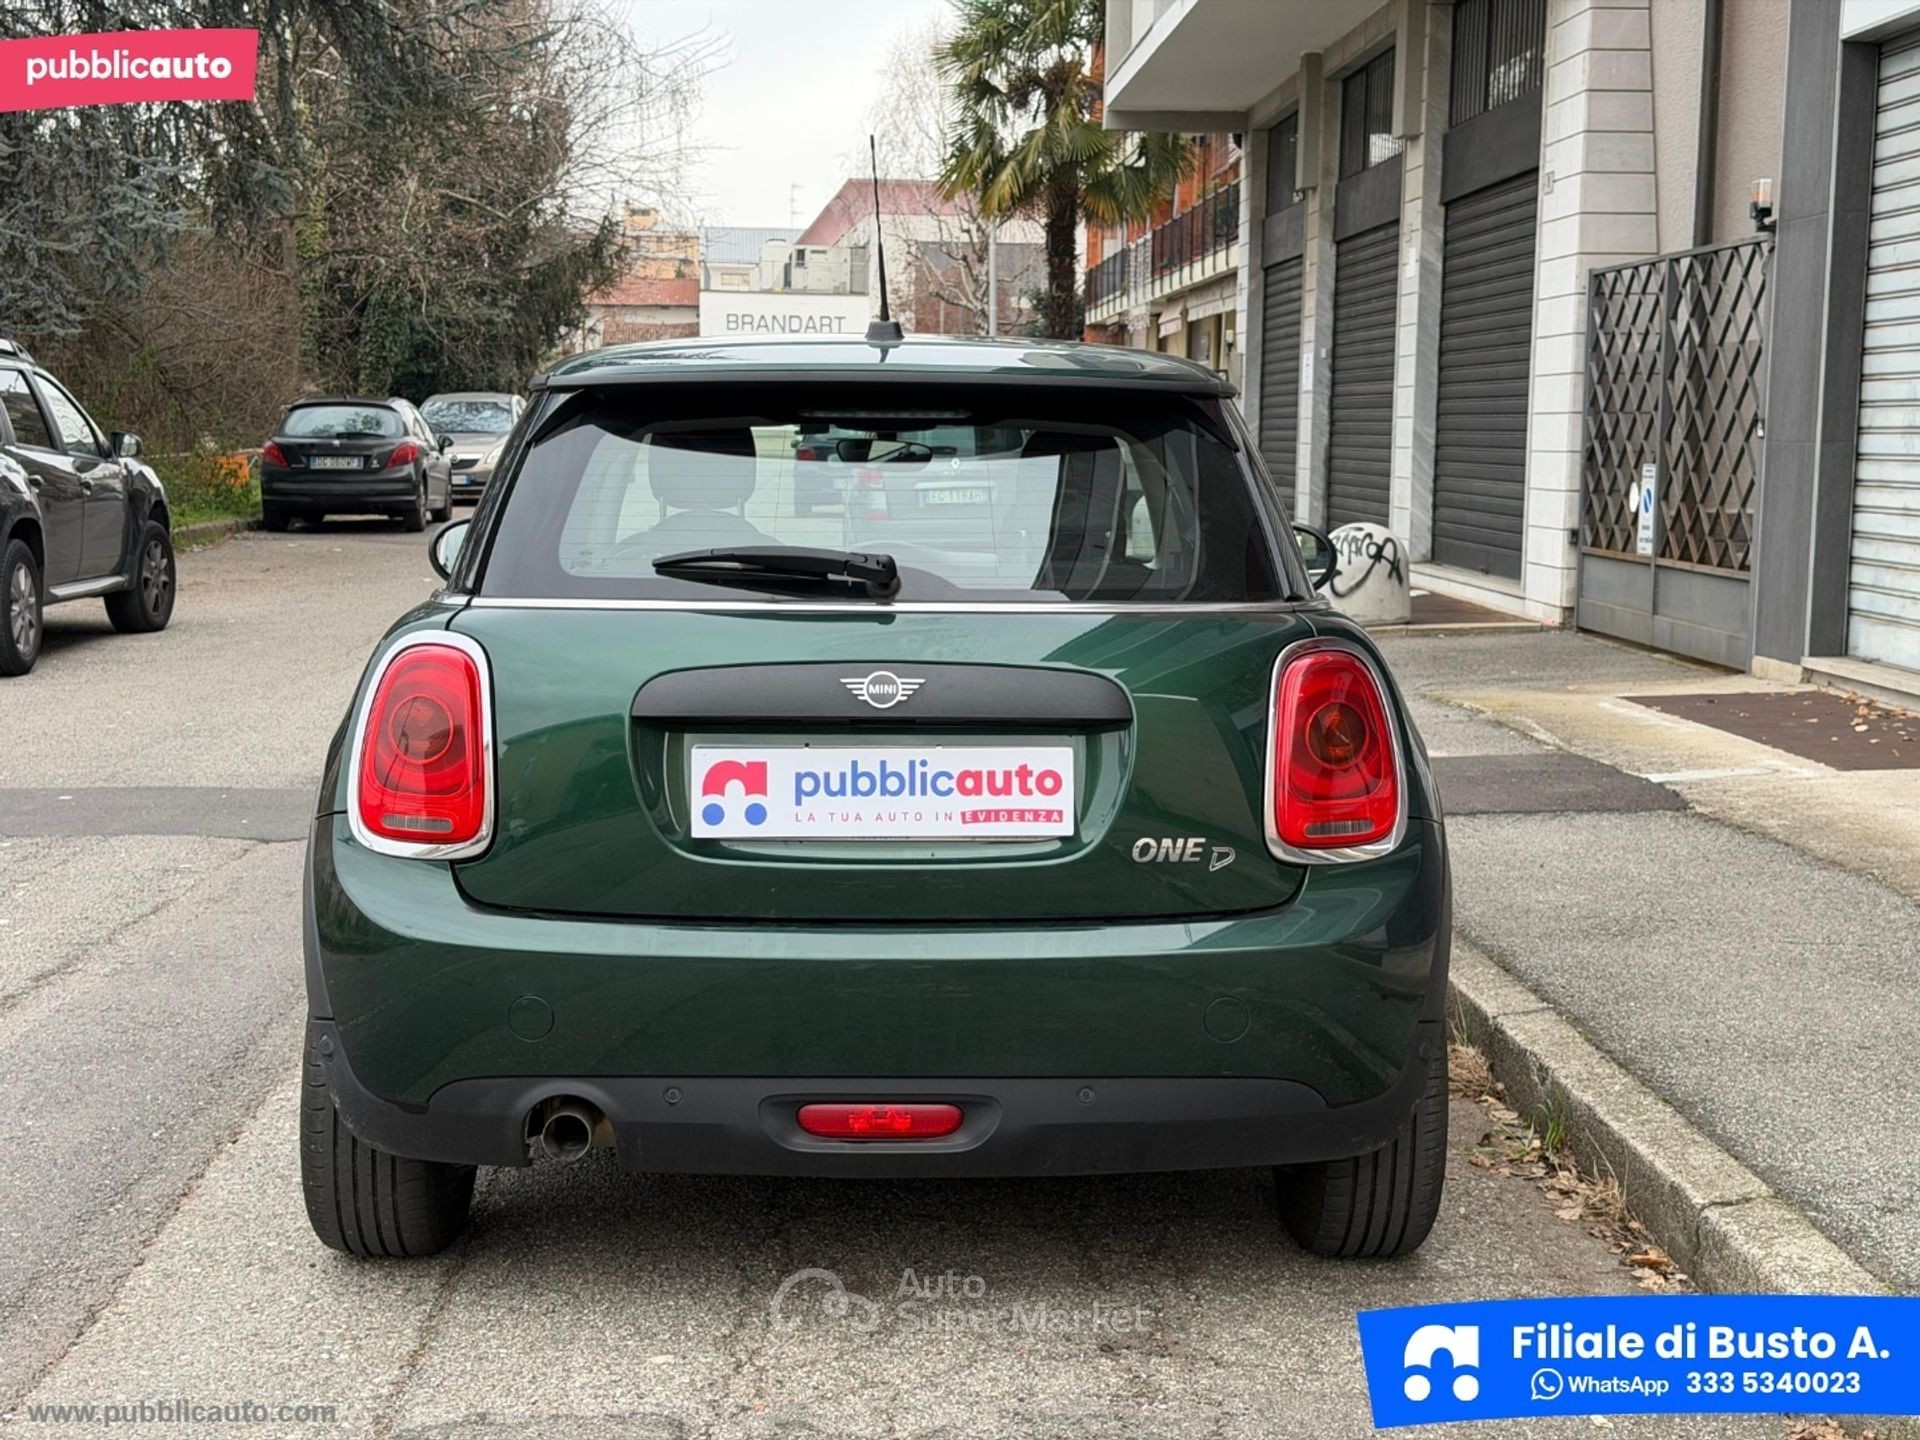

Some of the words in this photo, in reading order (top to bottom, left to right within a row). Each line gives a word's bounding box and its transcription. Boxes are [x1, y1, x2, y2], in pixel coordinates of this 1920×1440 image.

[726, 313, 847, 334] BRANDART
[868, 684, 898, 695] MINI
[794, 759, 1063, 807] pubblicauto
[795, 811, 816, 823] LA
[828, 811, 863, 823] TUA
[875, 811, 923, 823] AUTO
[935, 811, 953, 823] IN
[964, 810, 1061, 823] EVIDENZA
[1131, 837, 1207, 863] ONE
